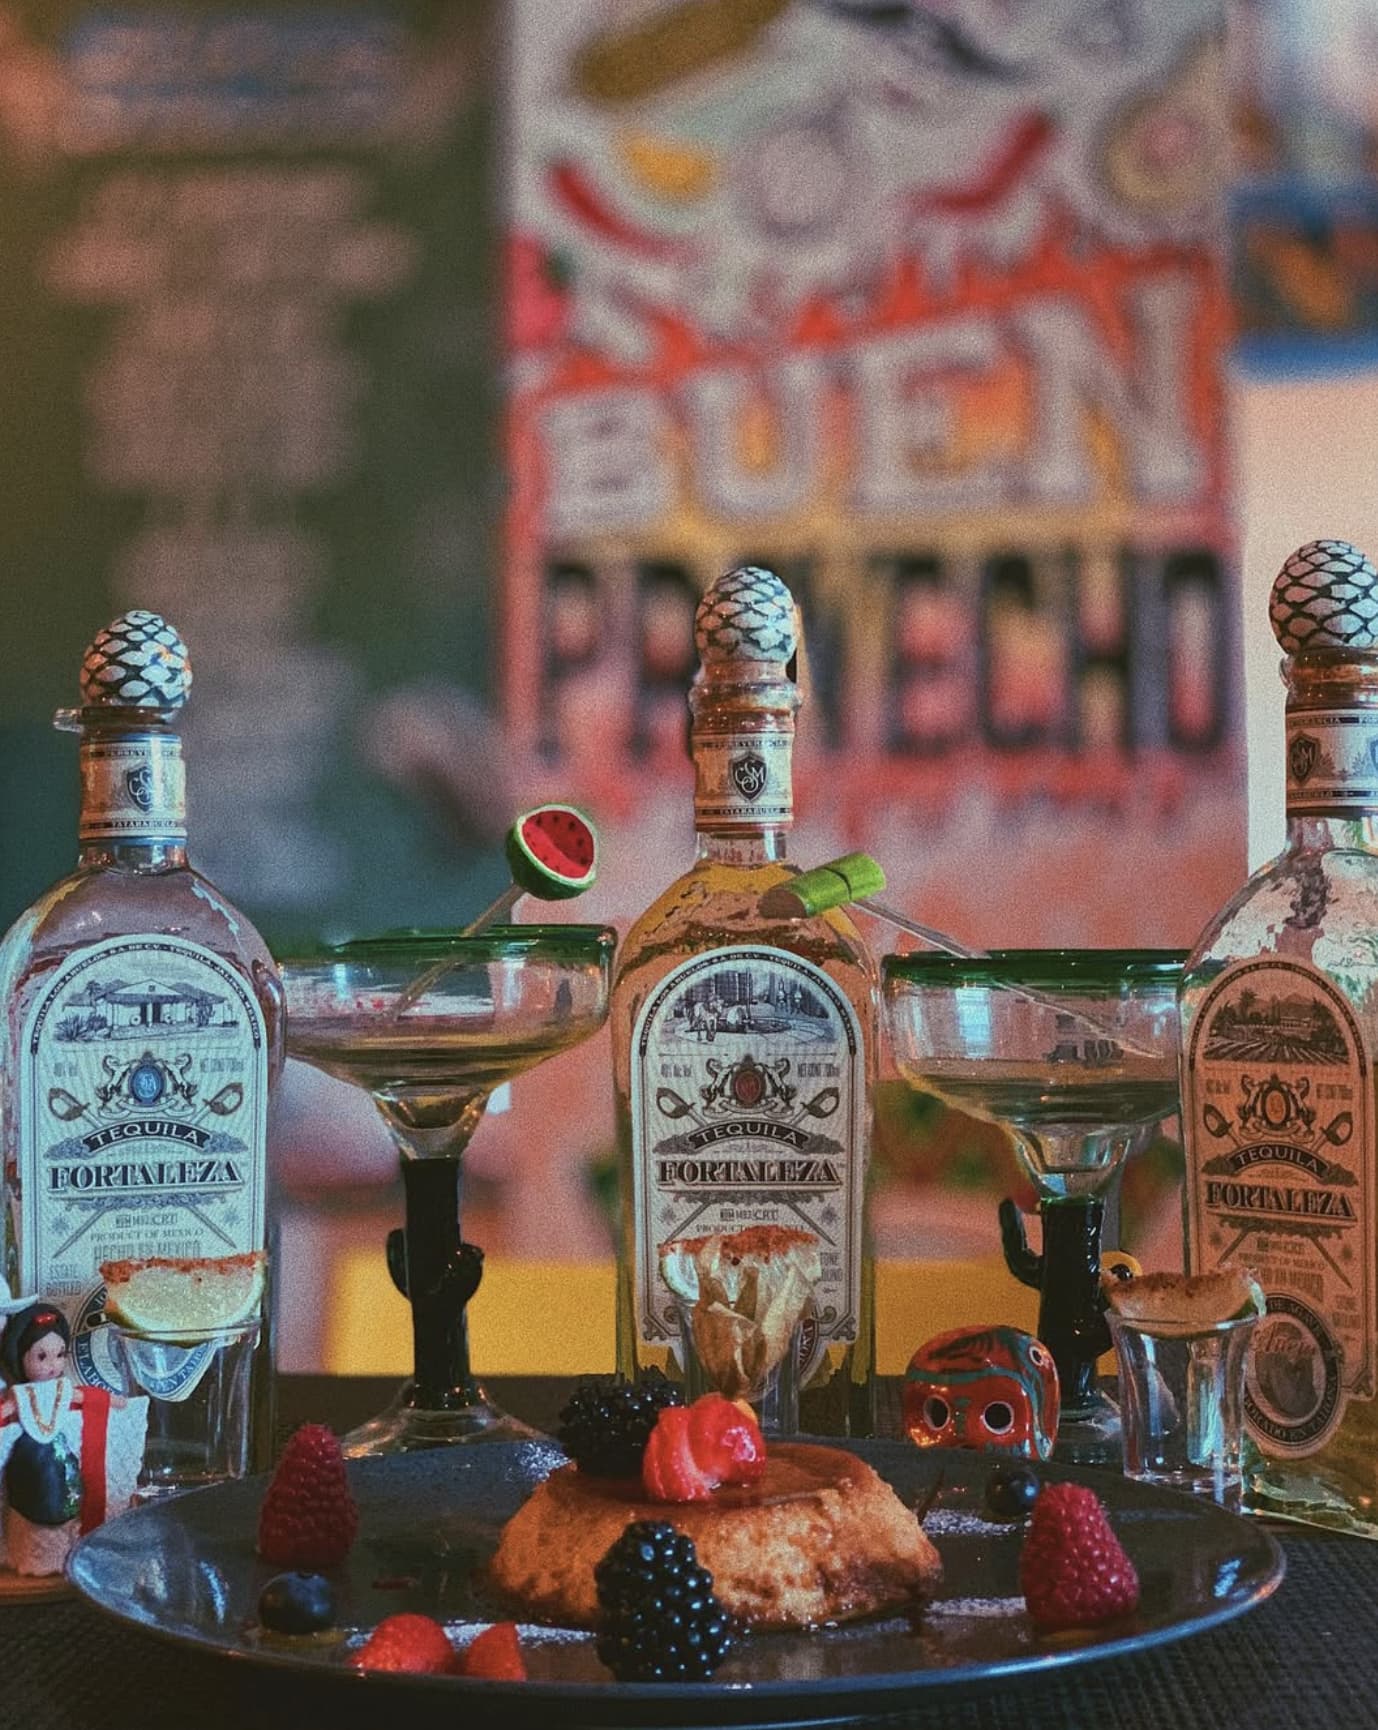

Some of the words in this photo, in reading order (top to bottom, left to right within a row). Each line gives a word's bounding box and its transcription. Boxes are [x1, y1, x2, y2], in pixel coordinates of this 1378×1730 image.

[540, 275, 1205, 532] BUEN
[538, 545, 1232, 768] PRVECHO
[90, 1121, 199, 1147] TEQUILA
[700, 1122, 798, 1144] TEQUILA
[657, 1159, 841, 1187] FORTALEZA
[1236, 1148, 1319, 1173] TEQUILA
[49, 1160, 242, 1192] FORTALEZA
[1207, 1181, 1356, 1219] FORTALEZA
